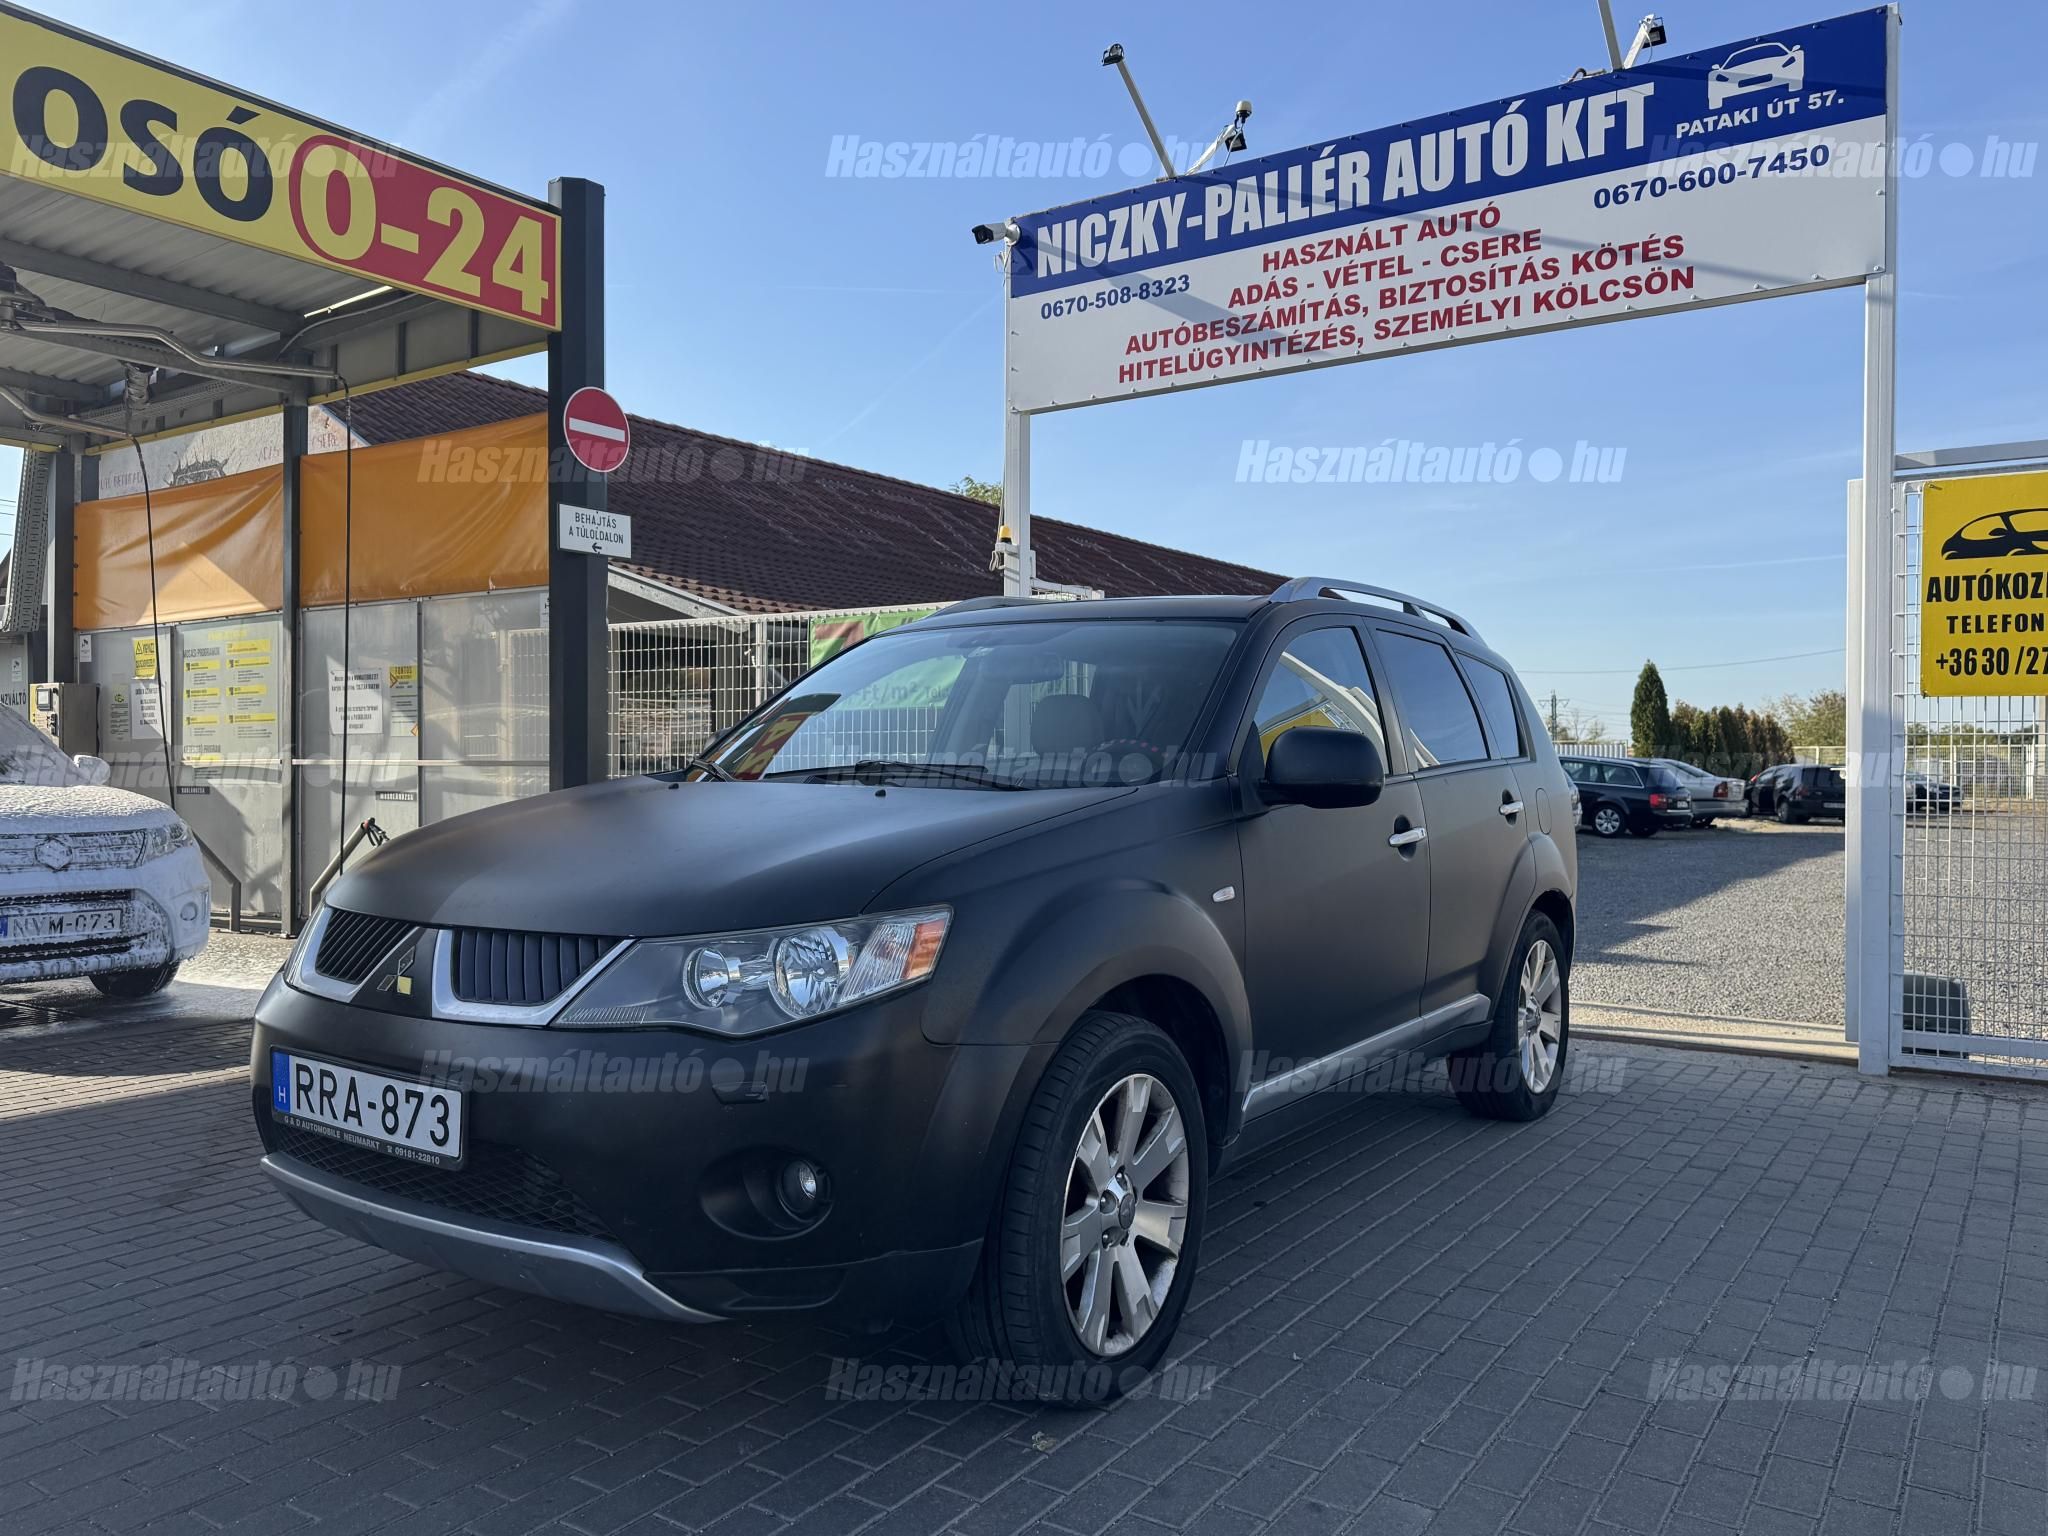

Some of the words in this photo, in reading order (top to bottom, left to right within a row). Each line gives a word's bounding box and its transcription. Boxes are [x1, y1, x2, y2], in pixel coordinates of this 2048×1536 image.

[13, 66, 273, 222] OSÓ
[1676, 106, 1758, 139] PATAKI
[1767, 98, 1800, 119] ÚT
[1807, 89, 1845, 110] 57.
[1037, 144, 1370, 279] NICZKY-PALLÉR
[1383, 99, 1529, 202] AUTÓ
[1546, 82, 1654, 167] KFT
[1593, 144, 1830, 209] 0670-600-7450
[299, 144, 550, 314] 0-24
[1262, 226, 1408, 273] HASZNÁLT
[1417, 201, 1501, 242] AUTÓ
[1041, 274, 1190, 320] 0670-508-8323
[1125, 292, 1369, 356] AUTÓBESZÁMÍTÁS,
[1379, 256, 1560, 310] BIZTOSÍTÁS
[1572, 233, 1685, 275] KÖTÉS
[1228, 276, 1298, 309] ADÁS
[1323, 255, 1413, 290] VÉTEL
[1440, 229, 1542, 267] CSERE
[1119, 323, 1364, 384] HITELÜGYINTÉZÉS,
[1374, 300, 1521, 341] SZEMÉLYI
[1533, 266, 1695, 314] KÖLCSÖN
[568, 525, 574, 536] A
[576, 526, 624, 545] TÚLOLDALON
[575, 512, 617, 529] BEHAJTÁS
[1926, 568, 2048, 602] AUTÓKOZ
[1946, 613, 2045, 634] TELEFON
[278, 1086, 286, 1104] H
[296, 1063, 449, 1147] RRA-873
[301, 1121, 341, 1140] AUTOMOBILE
[343, 1131, 380, 1151] NEUMARKT
[394, 1146, 440, 1165] 09181-22810
